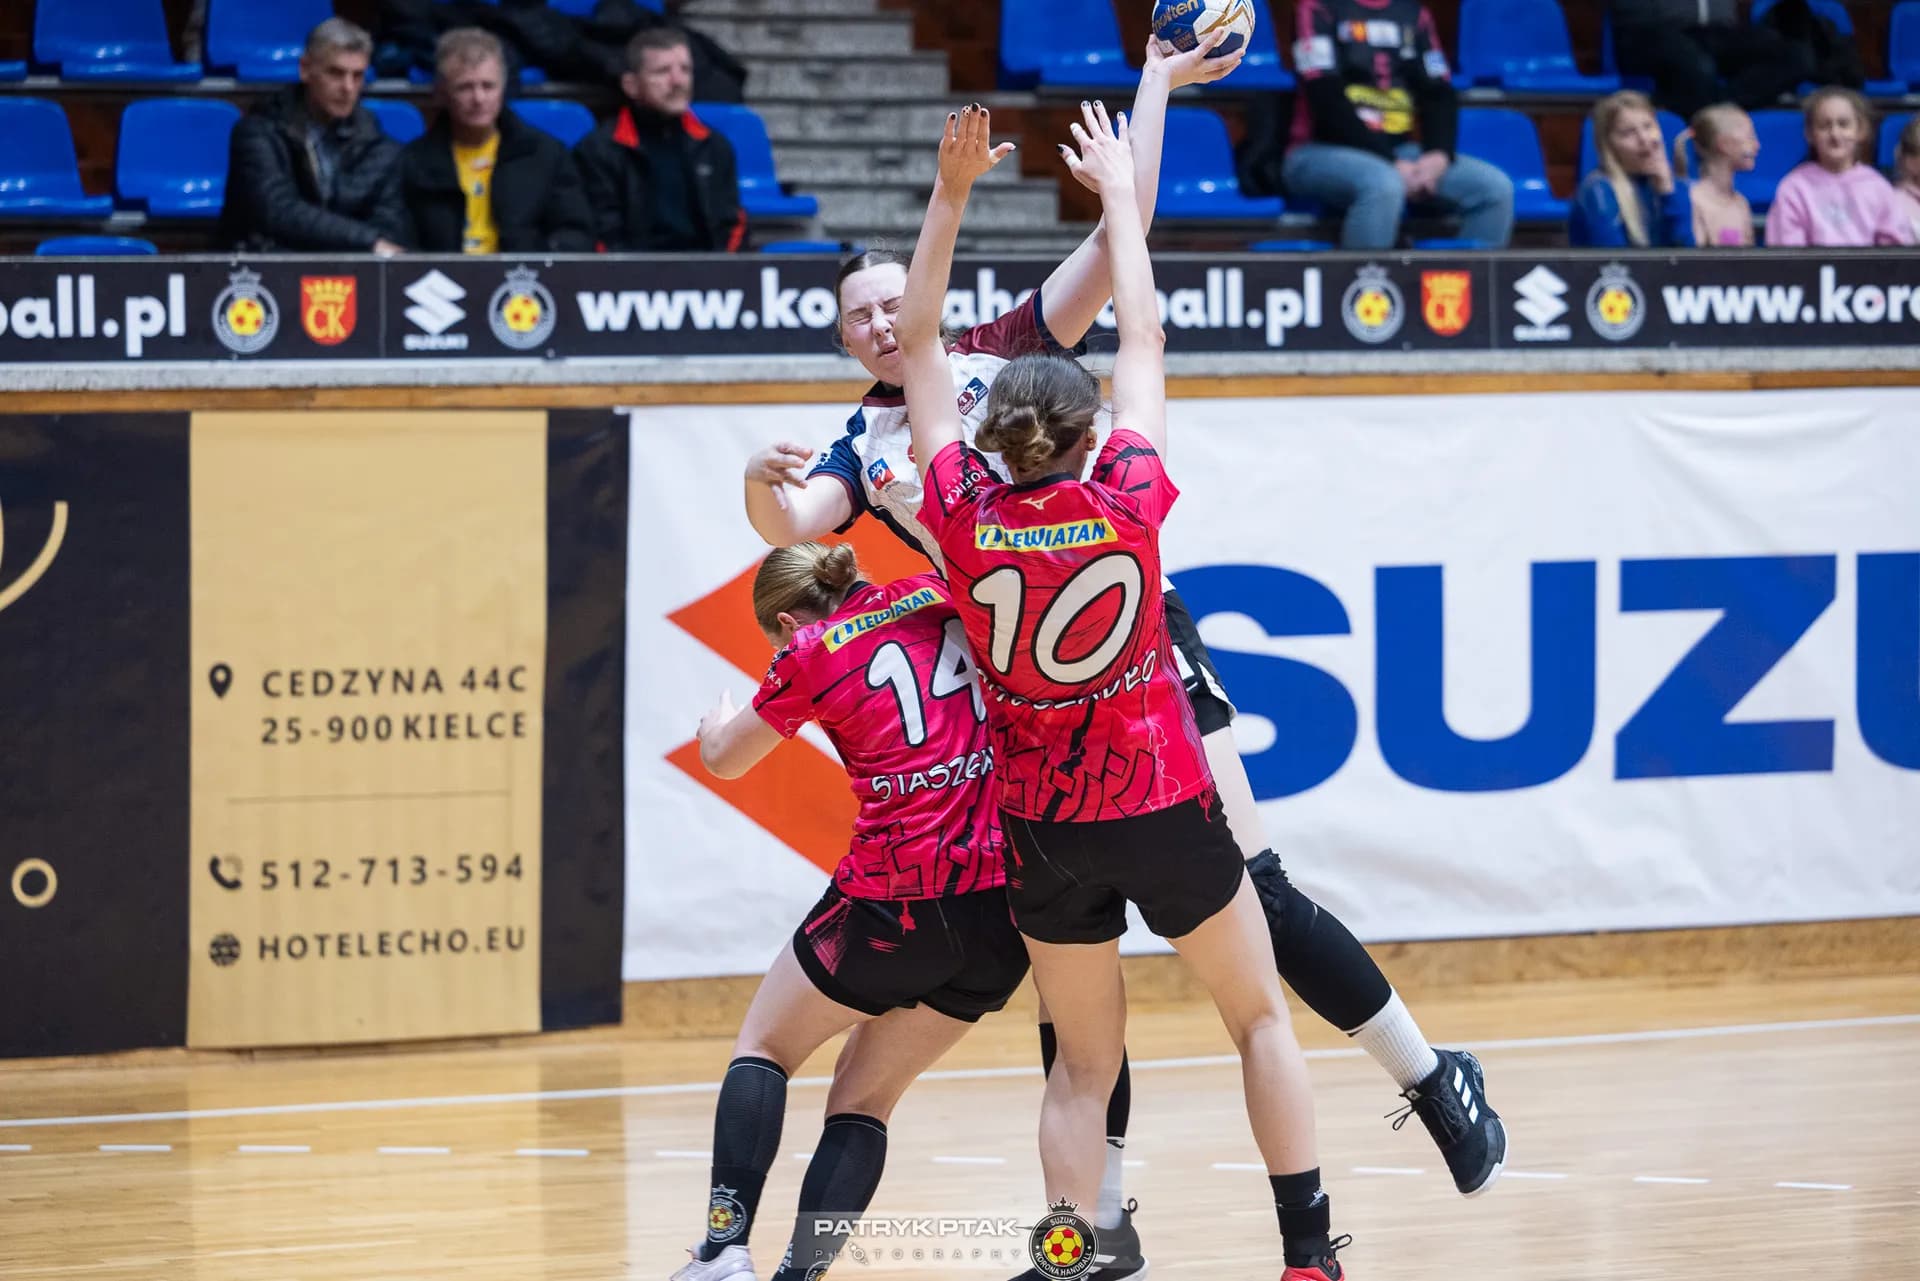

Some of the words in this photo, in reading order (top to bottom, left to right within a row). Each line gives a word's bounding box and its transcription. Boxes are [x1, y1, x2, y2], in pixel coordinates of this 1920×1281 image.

[0, 273, 187, 358] all.pl
[1004, 522, 1106, 548] LEWIATAN
[971, 553, 1142, 683] 10
[261, 667, 445, 698] CEDZYNA
[460, 665, 528, 692] 44C
[866, 617, 987, 748] 14
[260, 714, 394, 745] 25-900
[402, 711, 528, 741] KIELCE
[260, 853, 524, 891] 512-713-594
[257, 926, 526, 961] HOTELECHO.EU
